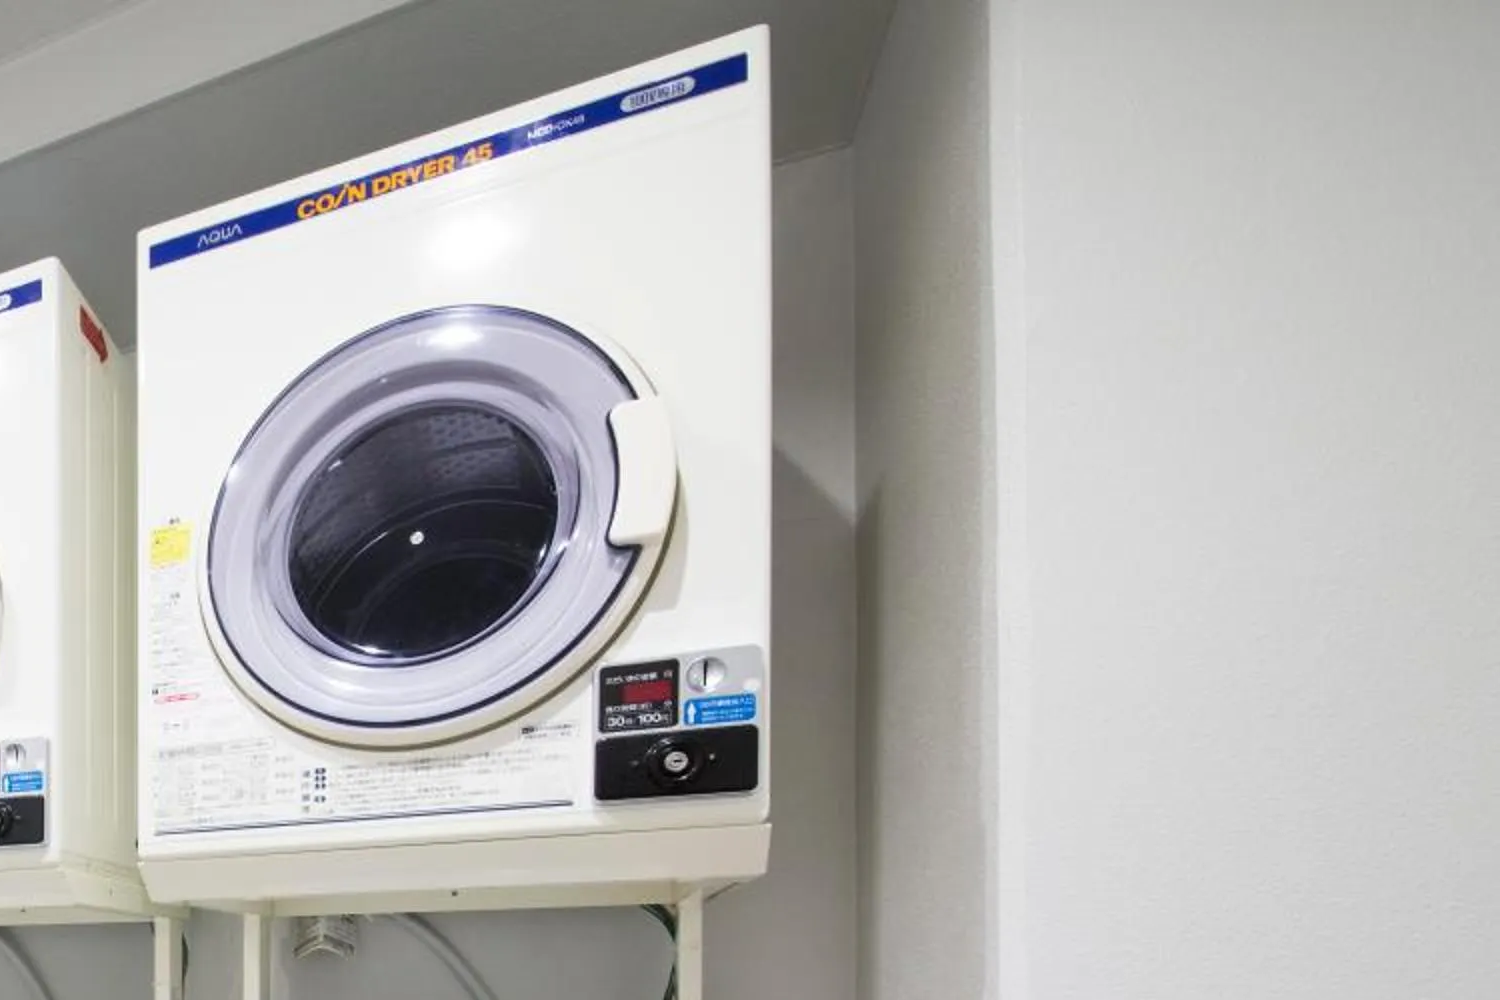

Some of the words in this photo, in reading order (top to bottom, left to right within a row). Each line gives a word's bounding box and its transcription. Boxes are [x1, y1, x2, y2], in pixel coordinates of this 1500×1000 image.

[197, 223, 243, 248] AQUA
[372, 155, 455, 196] DRYER
[461, 143, 493, 166] 45
